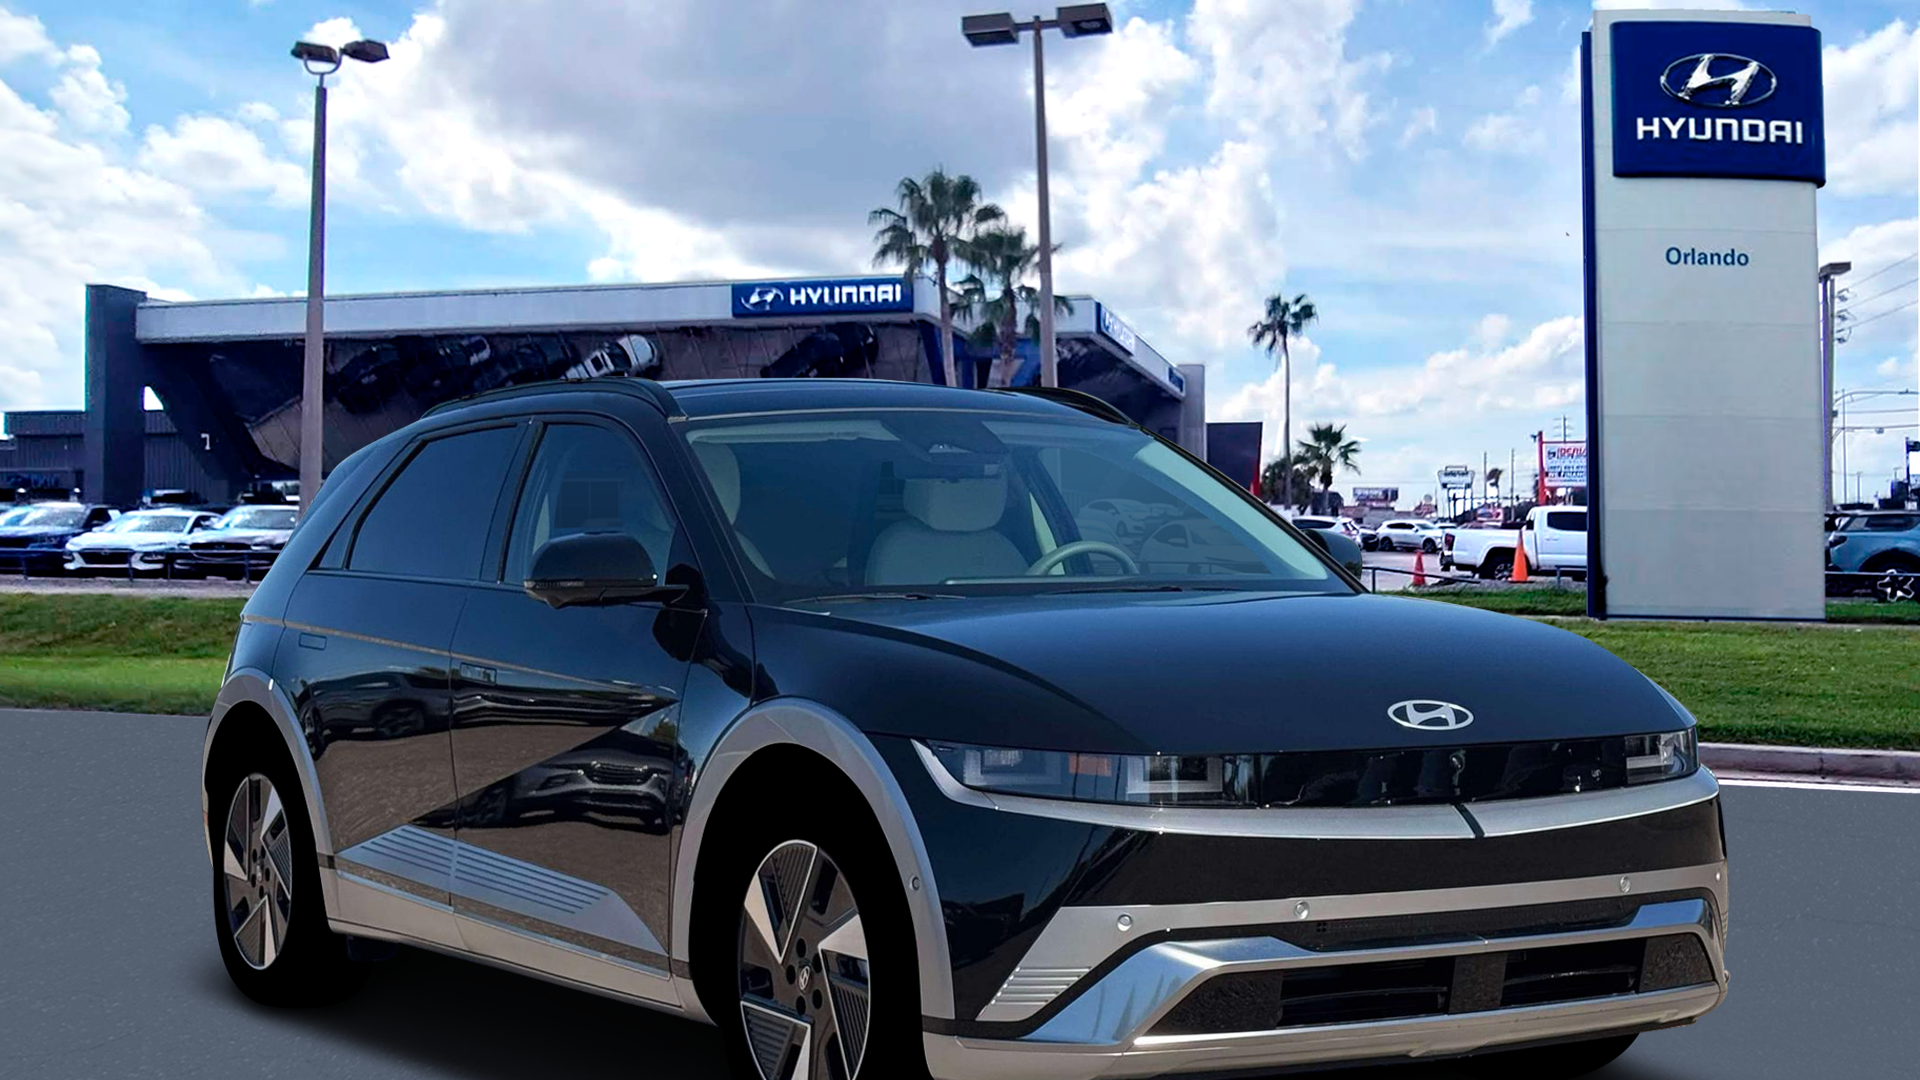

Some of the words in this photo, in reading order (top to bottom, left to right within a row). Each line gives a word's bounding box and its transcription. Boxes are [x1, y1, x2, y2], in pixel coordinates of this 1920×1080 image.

[1636, 117, 1803, 144] HYUNDAI
[1665, 247, 1750, 266] Orlando
[789, 284, 902, 306] HYUNDAI
